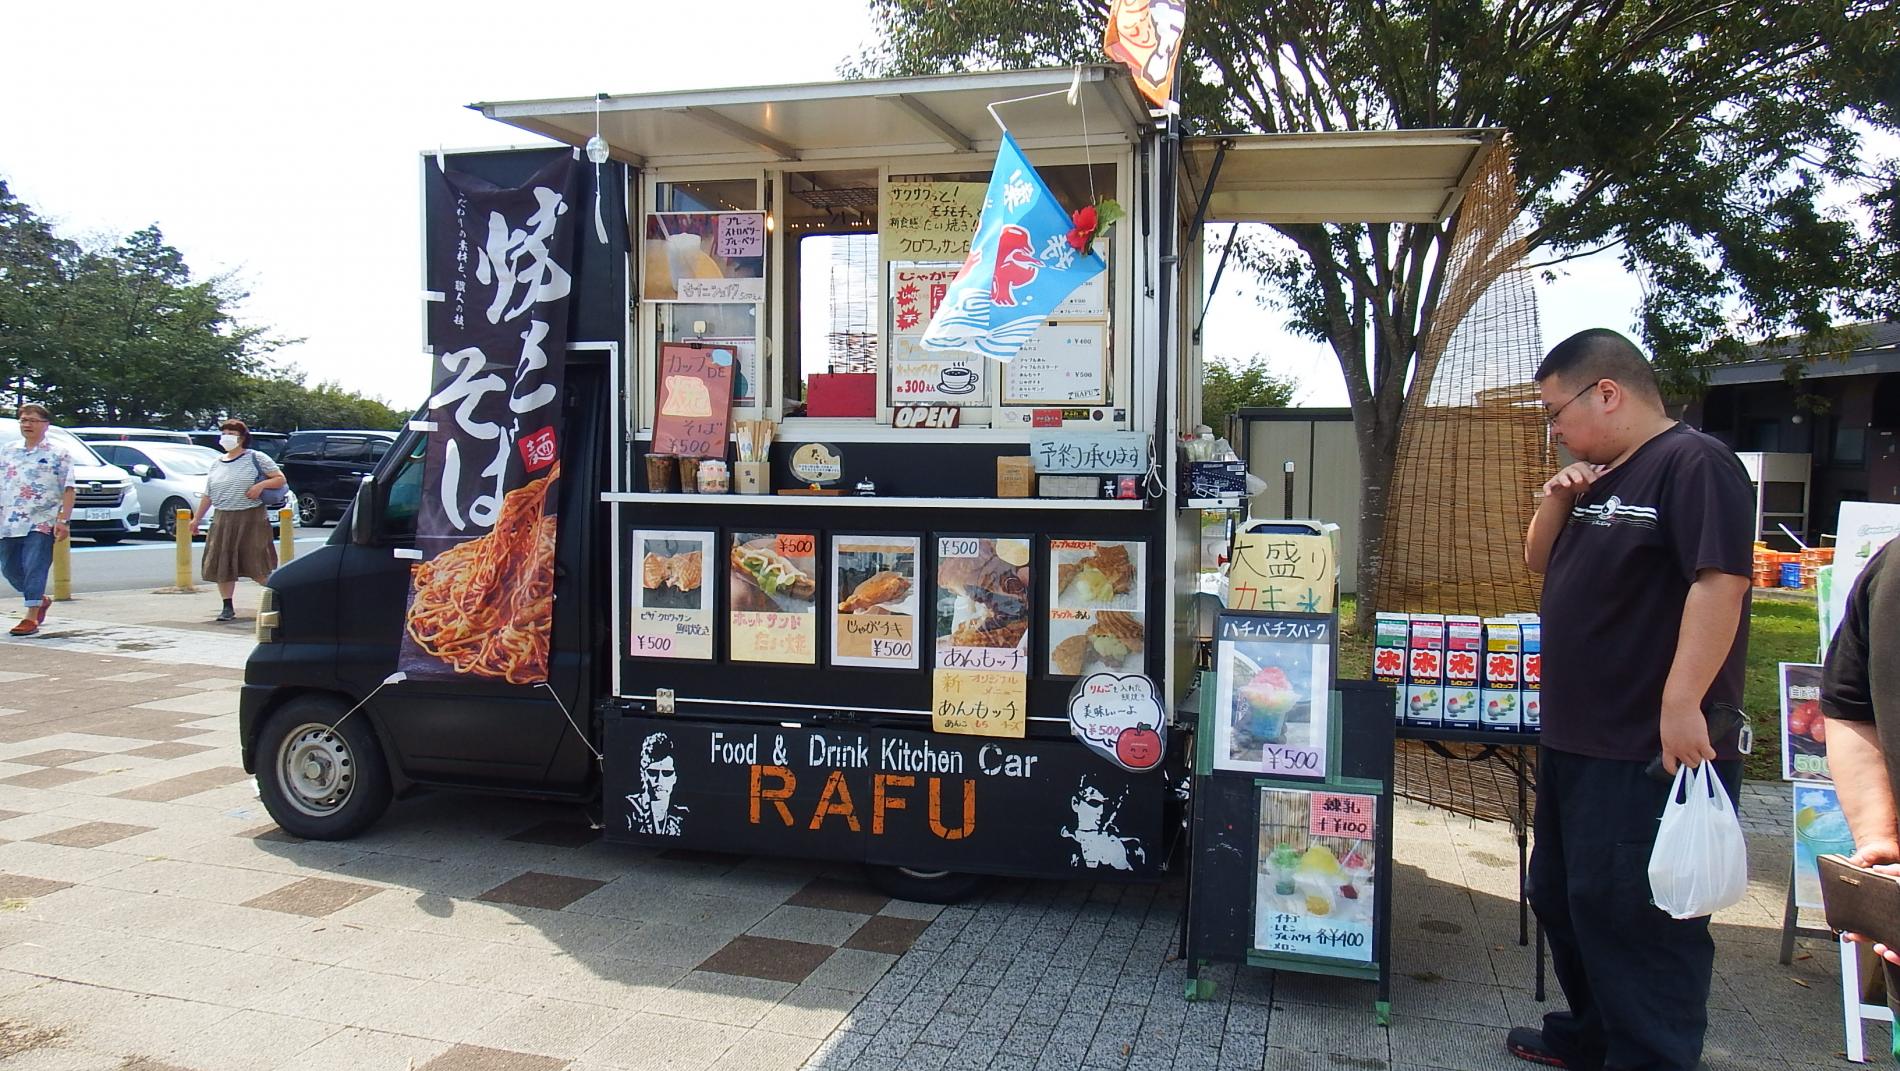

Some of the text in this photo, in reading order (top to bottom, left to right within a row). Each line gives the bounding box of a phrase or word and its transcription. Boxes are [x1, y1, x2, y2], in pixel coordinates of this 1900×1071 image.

[707, 367, 727, 379] DE
[895, 407, 958, 428] OPEN
[1040, 442, 1140, 469] 予約承ります
[779, 538, 813, 553] ¥500
[941, 540, 978, 555] ¥500
[1232, 540, 1327, 581] 大盛り
[1235, 581, 1322, 613] カキ氷
[637, 635, 671, 651] ¥500
[874, 640, 912, 656] ¥500
[1376, 650, 1401, 671] 氷
[1413, 652, 1438, 673] 氷
[1449, 654, 1475, 675] 氷
[1488, 656, 1515, 676] 氷
[1089, 723, 1120, 736] ¥500
[711, 732, 1038, 778] Food & Drink Kitchen Car
[1268, 747, 1319, 770] ¥500
[750, 764, 976, 840] RAFU
